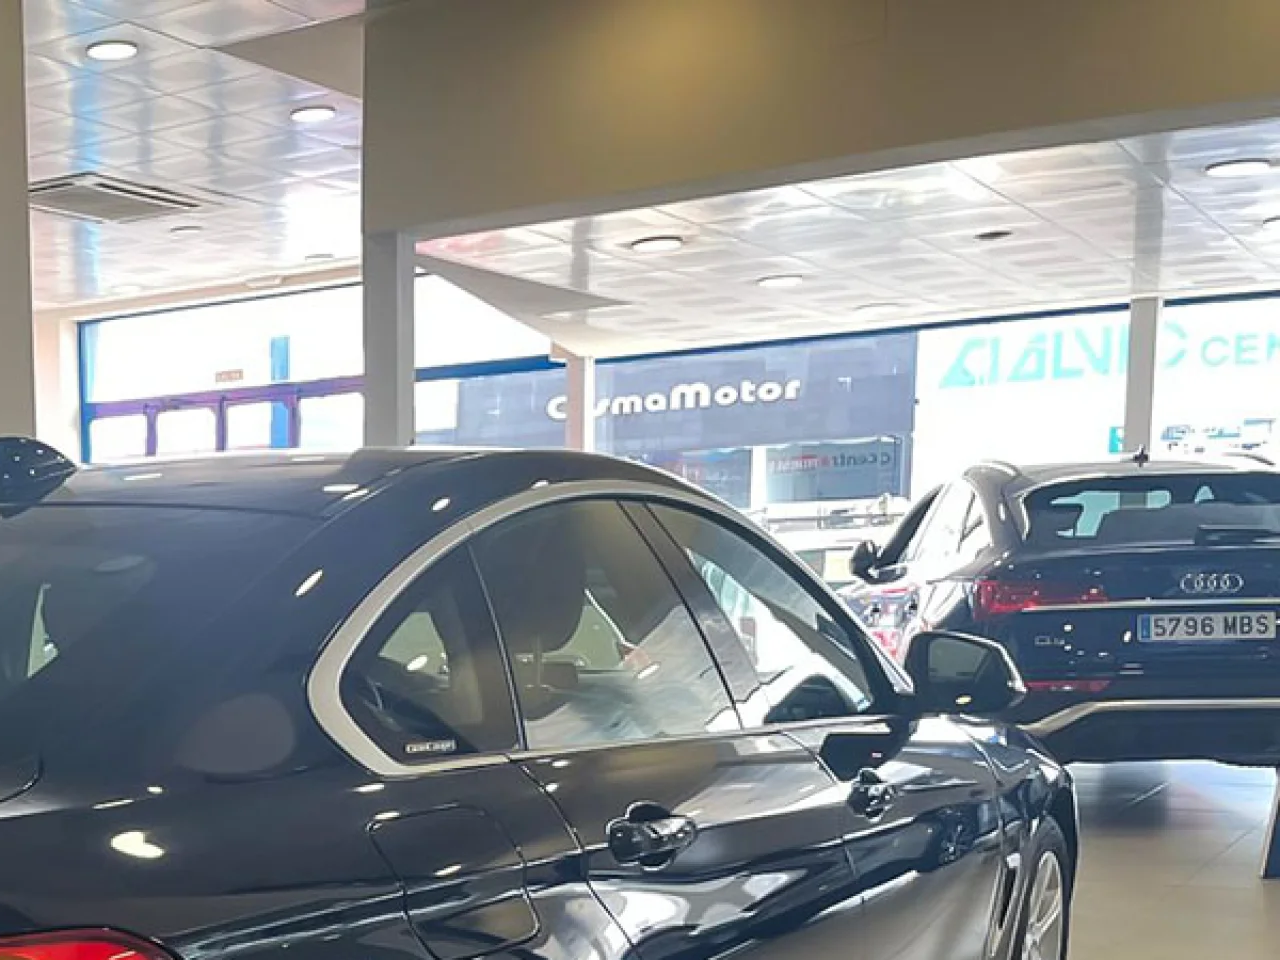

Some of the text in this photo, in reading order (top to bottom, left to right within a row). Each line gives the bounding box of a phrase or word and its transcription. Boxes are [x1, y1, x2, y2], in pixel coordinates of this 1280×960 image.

[546, 378, 801, 420] CsmaMotor
[1153, 615, 1215, 637] 5796
[1223, 613, 1269, 635] MBS
